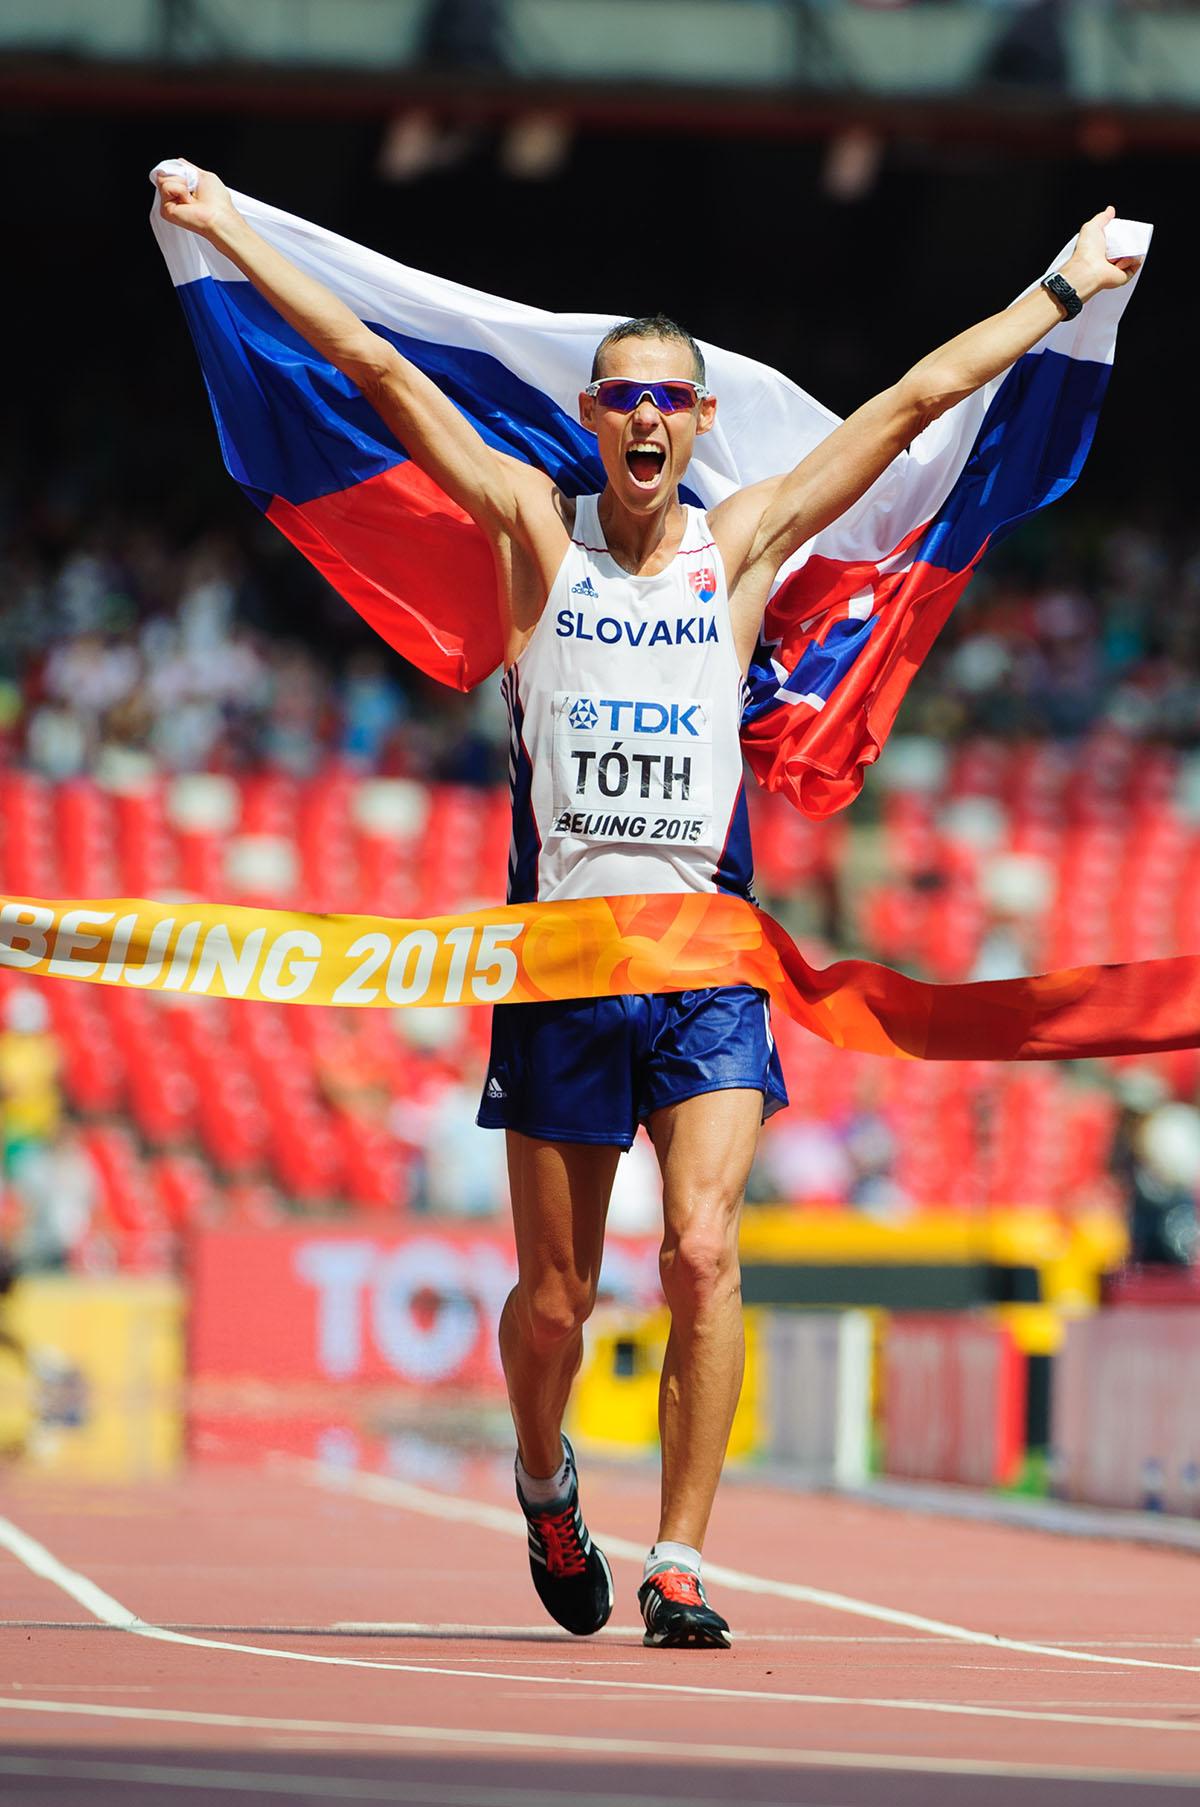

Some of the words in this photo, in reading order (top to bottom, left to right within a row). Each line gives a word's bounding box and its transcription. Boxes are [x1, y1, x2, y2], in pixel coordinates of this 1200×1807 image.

[571, 585, 599, 599] adidas
[556, 610, 719, 647] SLOVAKIA
[599, 699, 699, 736] TDK
[571, 742, 692, 800] TÓTH
[555, 812, 646, 837] BEIJING
[650, 818, 703, 842] 2015
[0, 904, 322, 1000] BEIJING
[332, 923, 525, 1004] 2015
